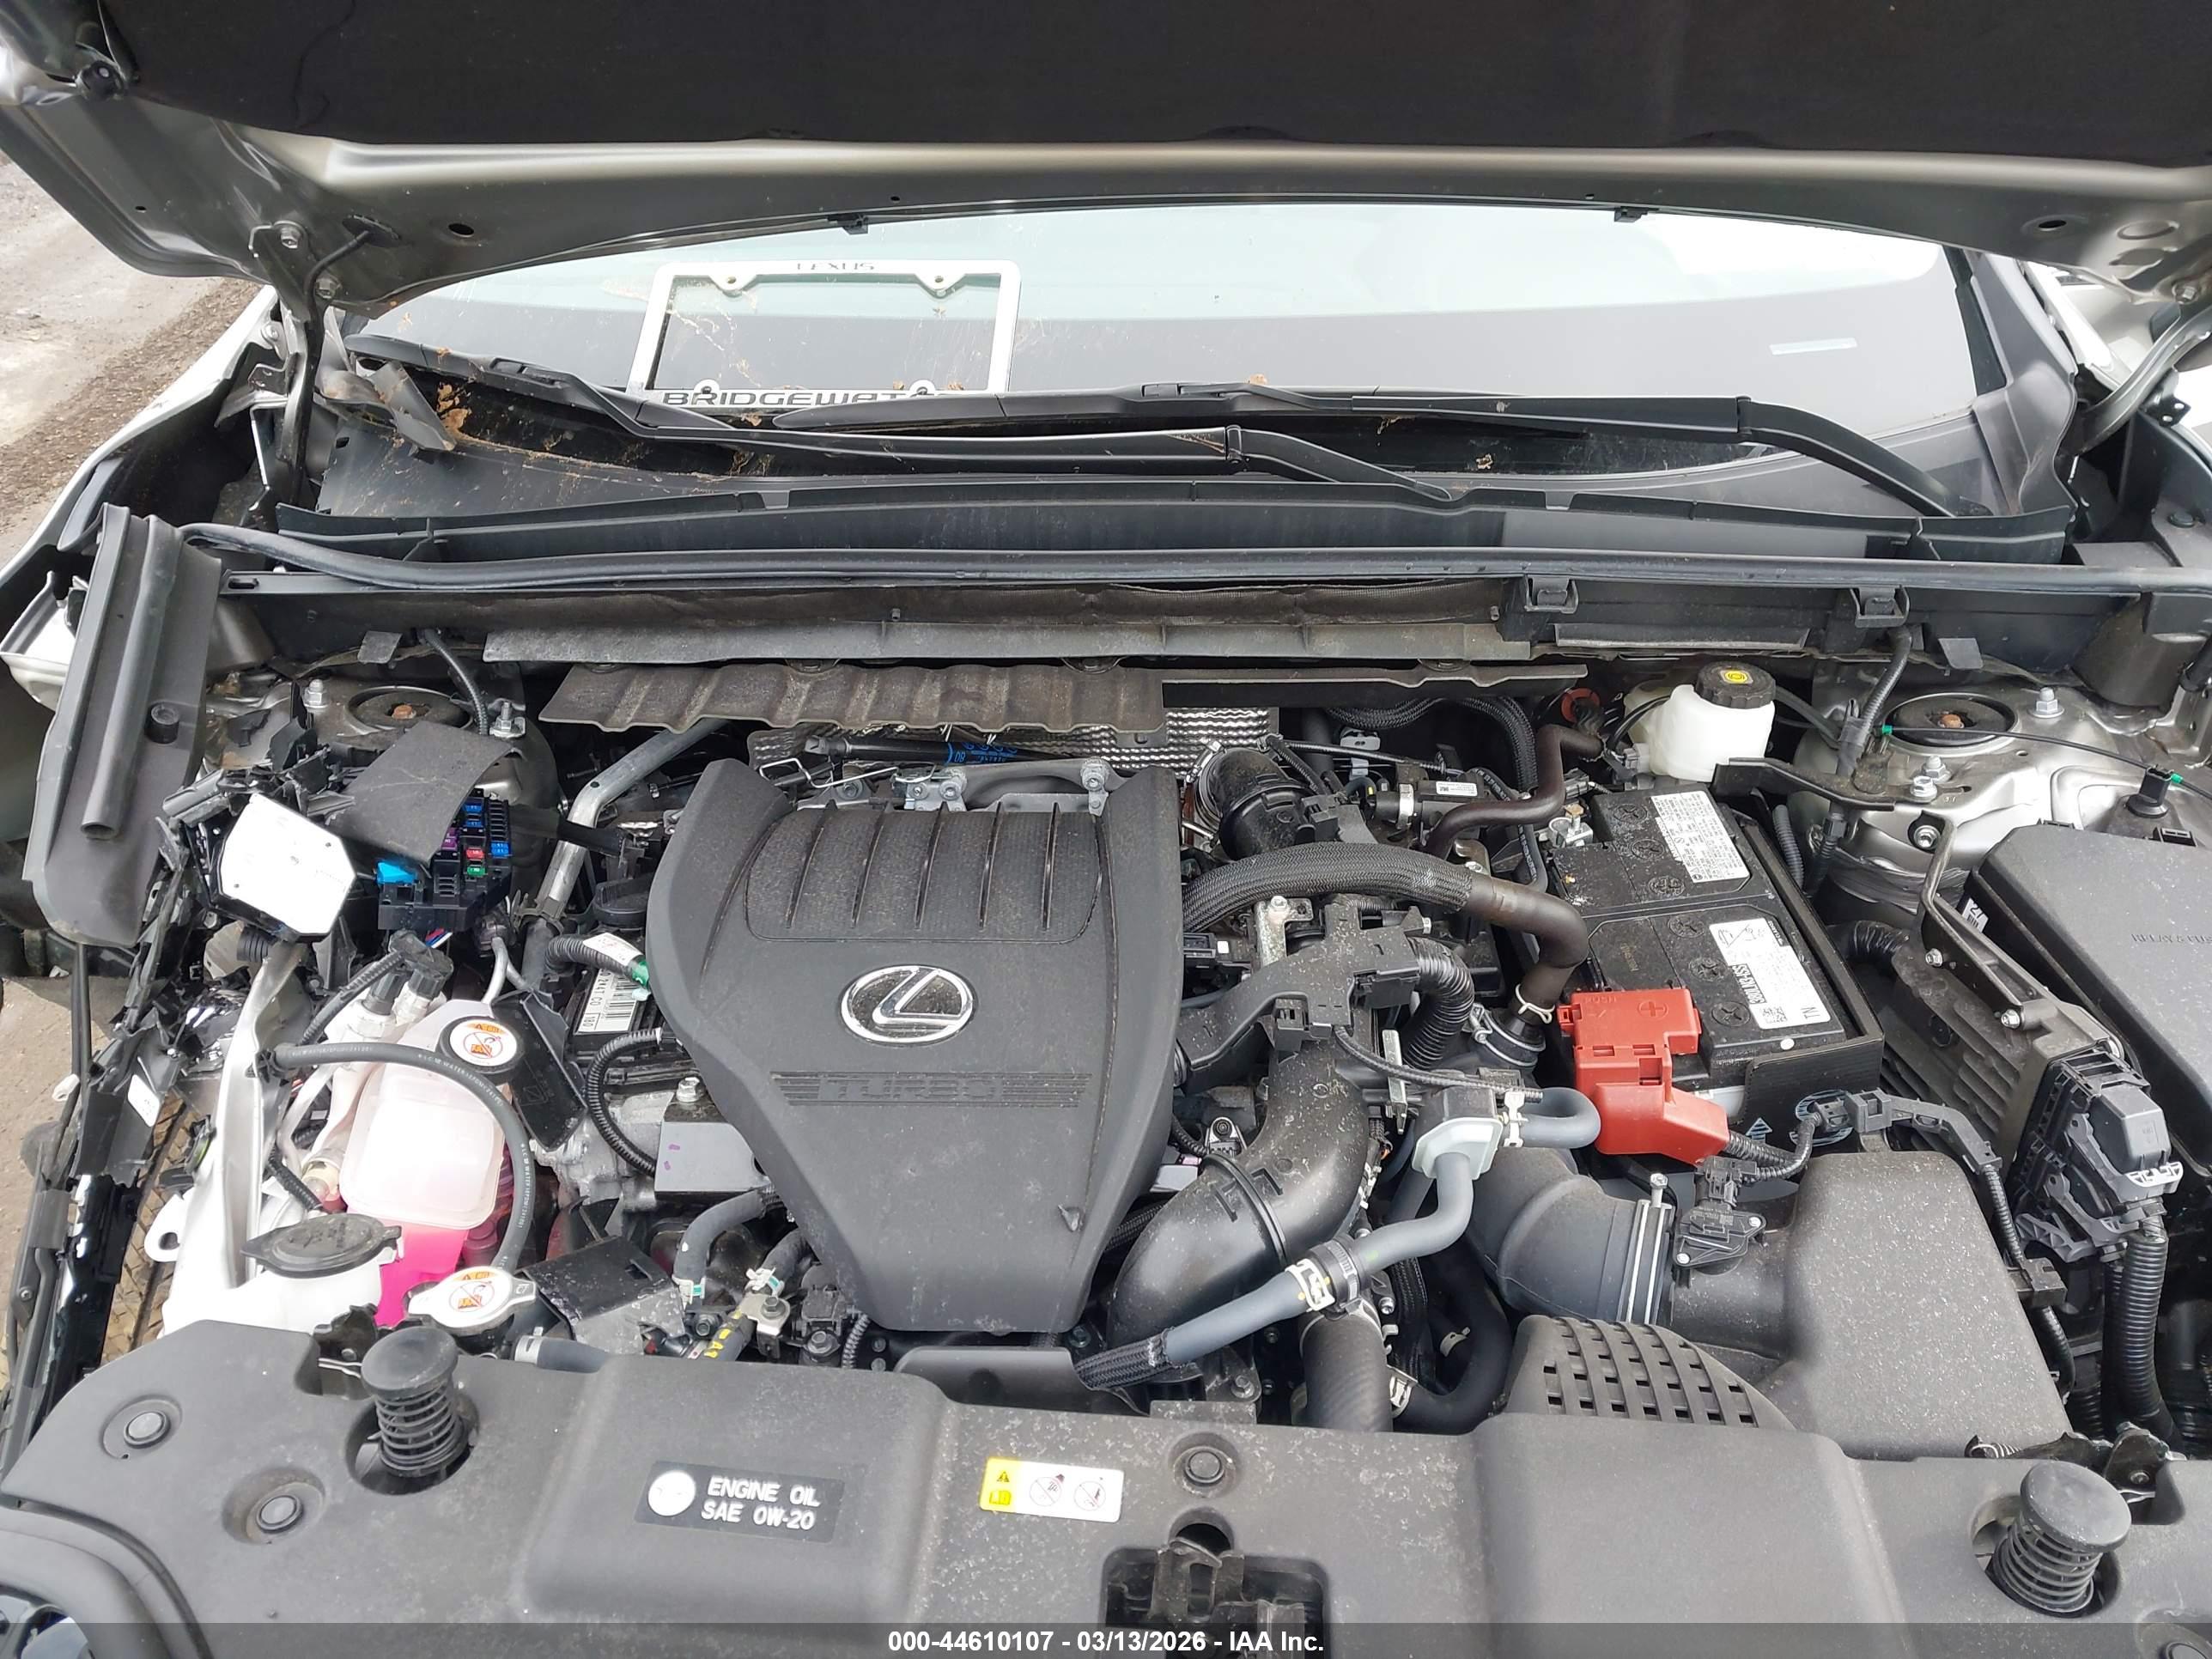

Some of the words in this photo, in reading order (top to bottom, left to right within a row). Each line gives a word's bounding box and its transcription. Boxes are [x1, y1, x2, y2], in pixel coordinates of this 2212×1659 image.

[825, 1078, 995, 1100] TURBO
[708, 1475, 781, 1502] ENGINE
[789, 1484, 821, 1507] OIL
[701, 1497, 744, 1522] SAE
[752, 1504, 816, 1530] 0W-20
